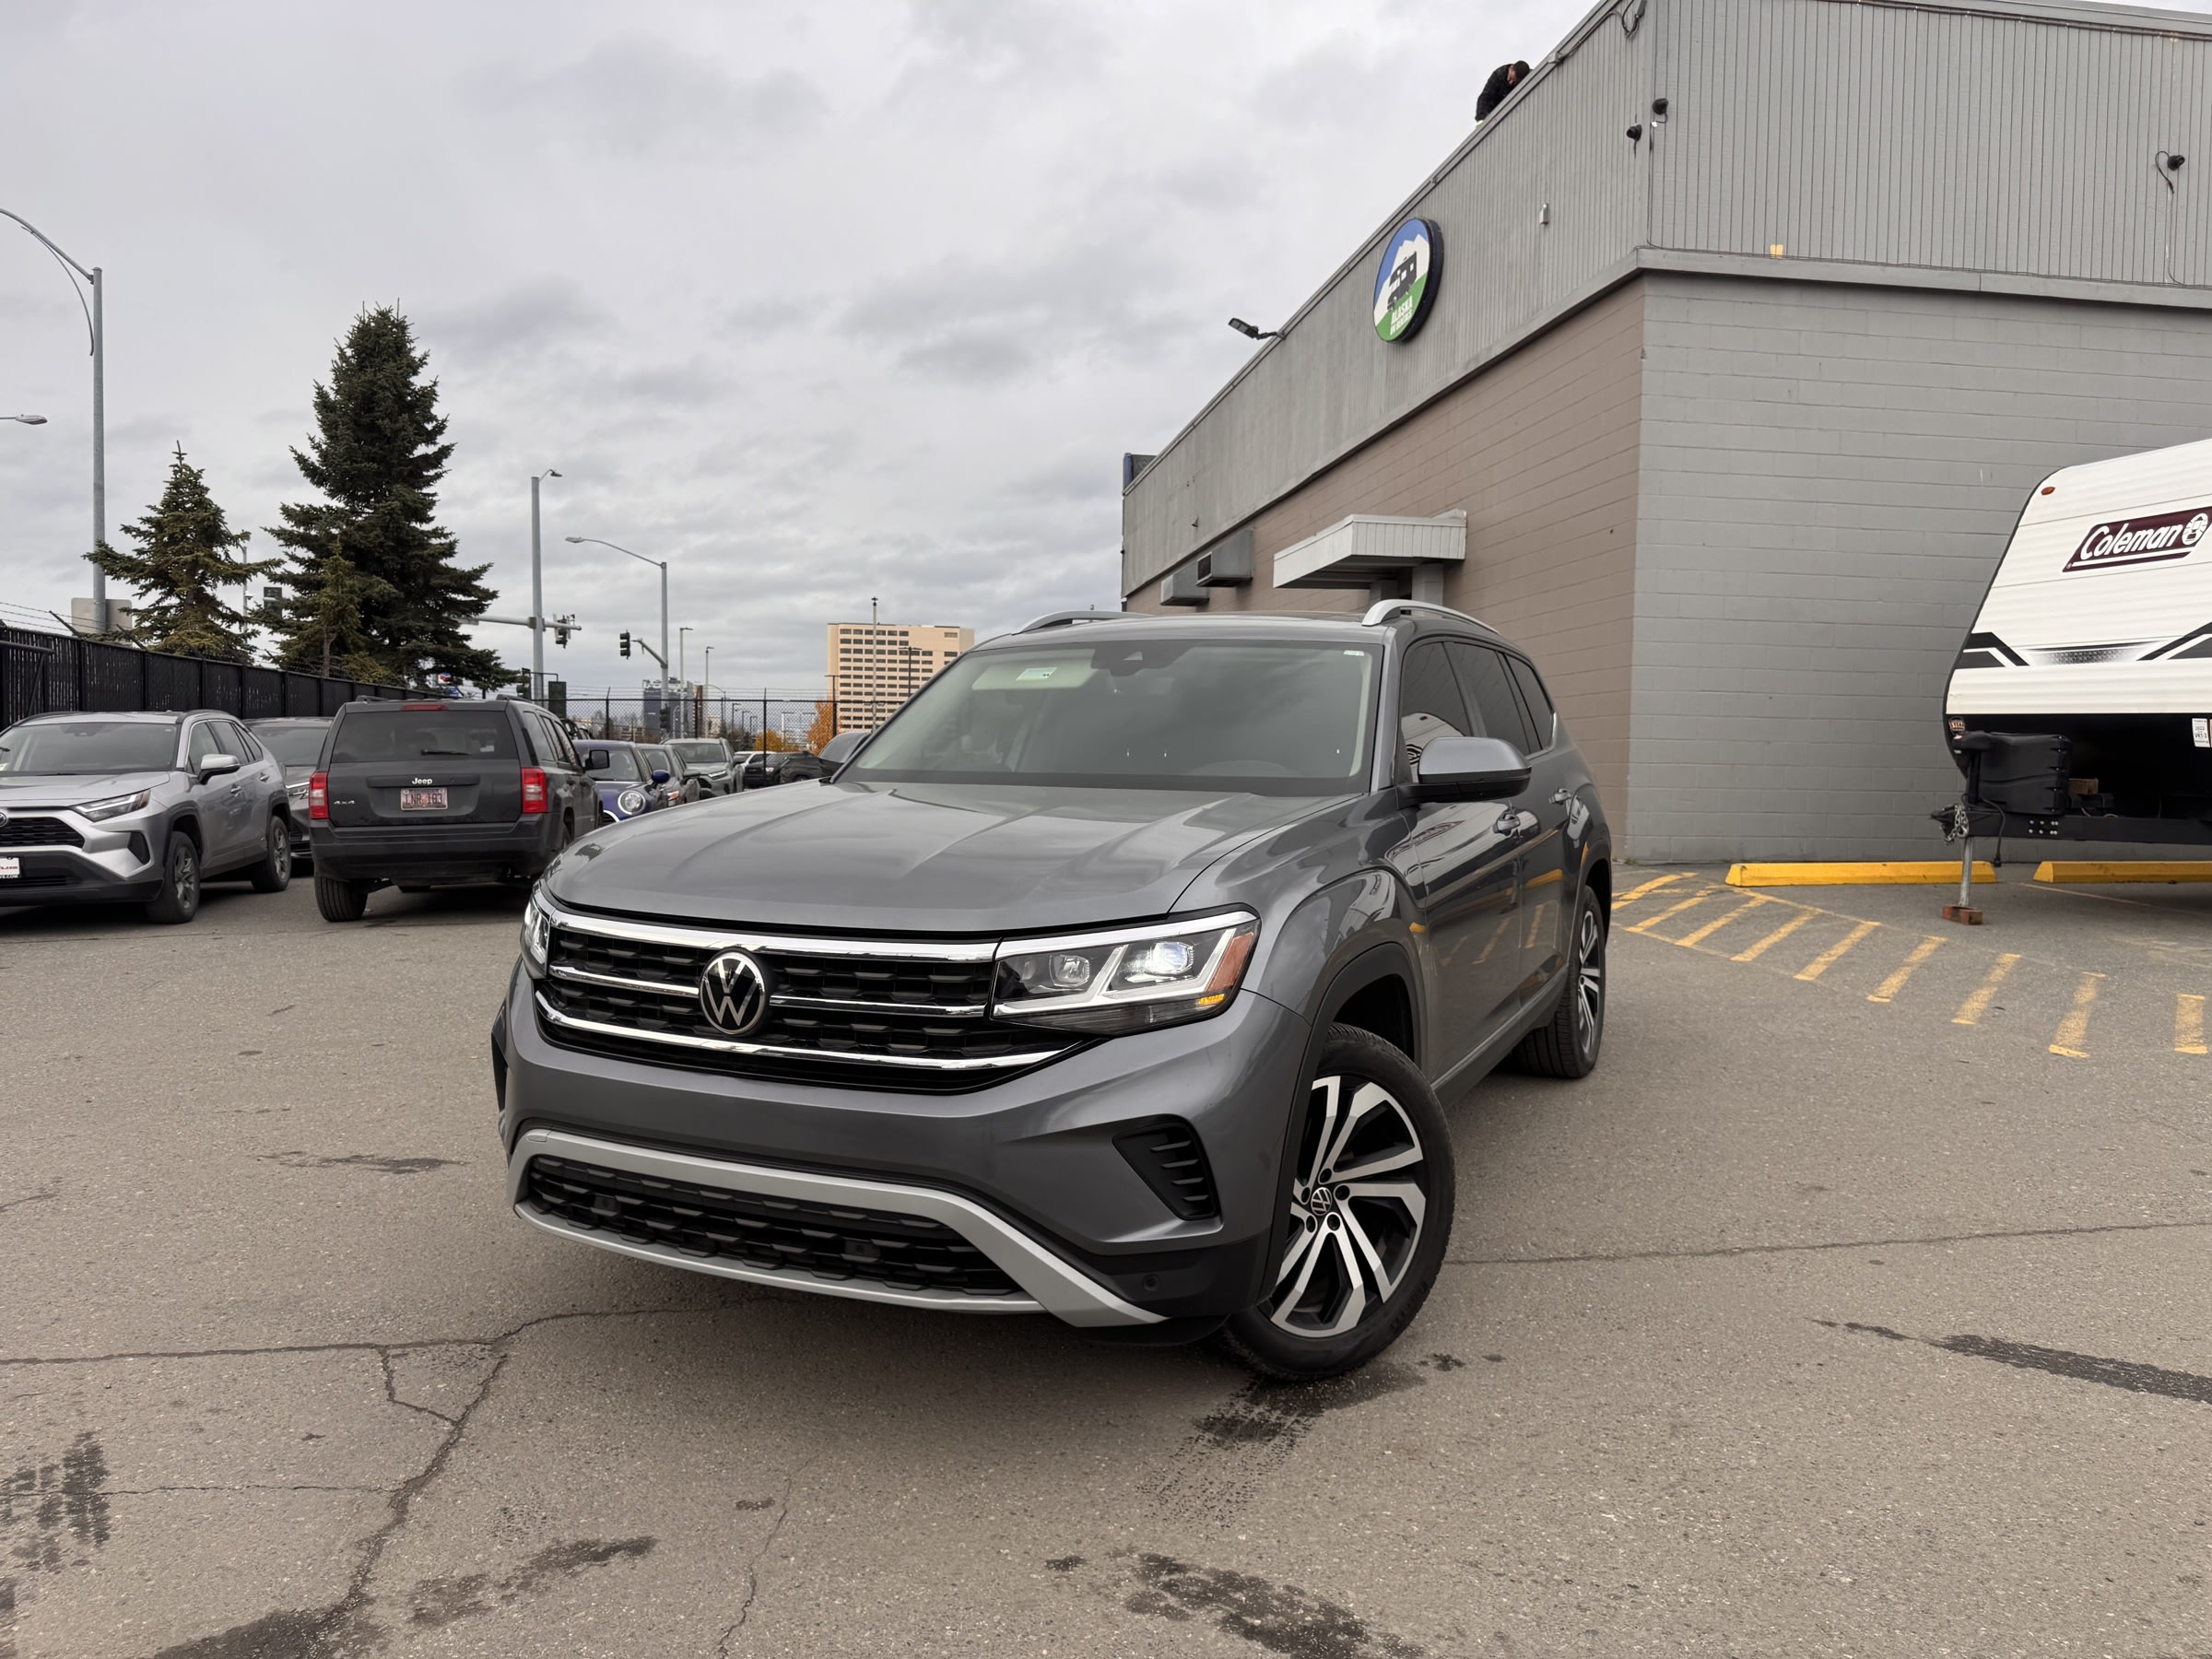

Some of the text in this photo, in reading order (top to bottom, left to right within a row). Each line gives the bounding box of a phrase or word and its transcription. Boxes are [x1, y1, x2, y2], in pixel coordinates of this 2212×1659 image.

[1391, 295, 1413, 325] ALASKA
[2080, 523, 2183, 560] Coleman
[411, 777, 433, 785] Jeep
[702, 954, 763, 1030] VW
